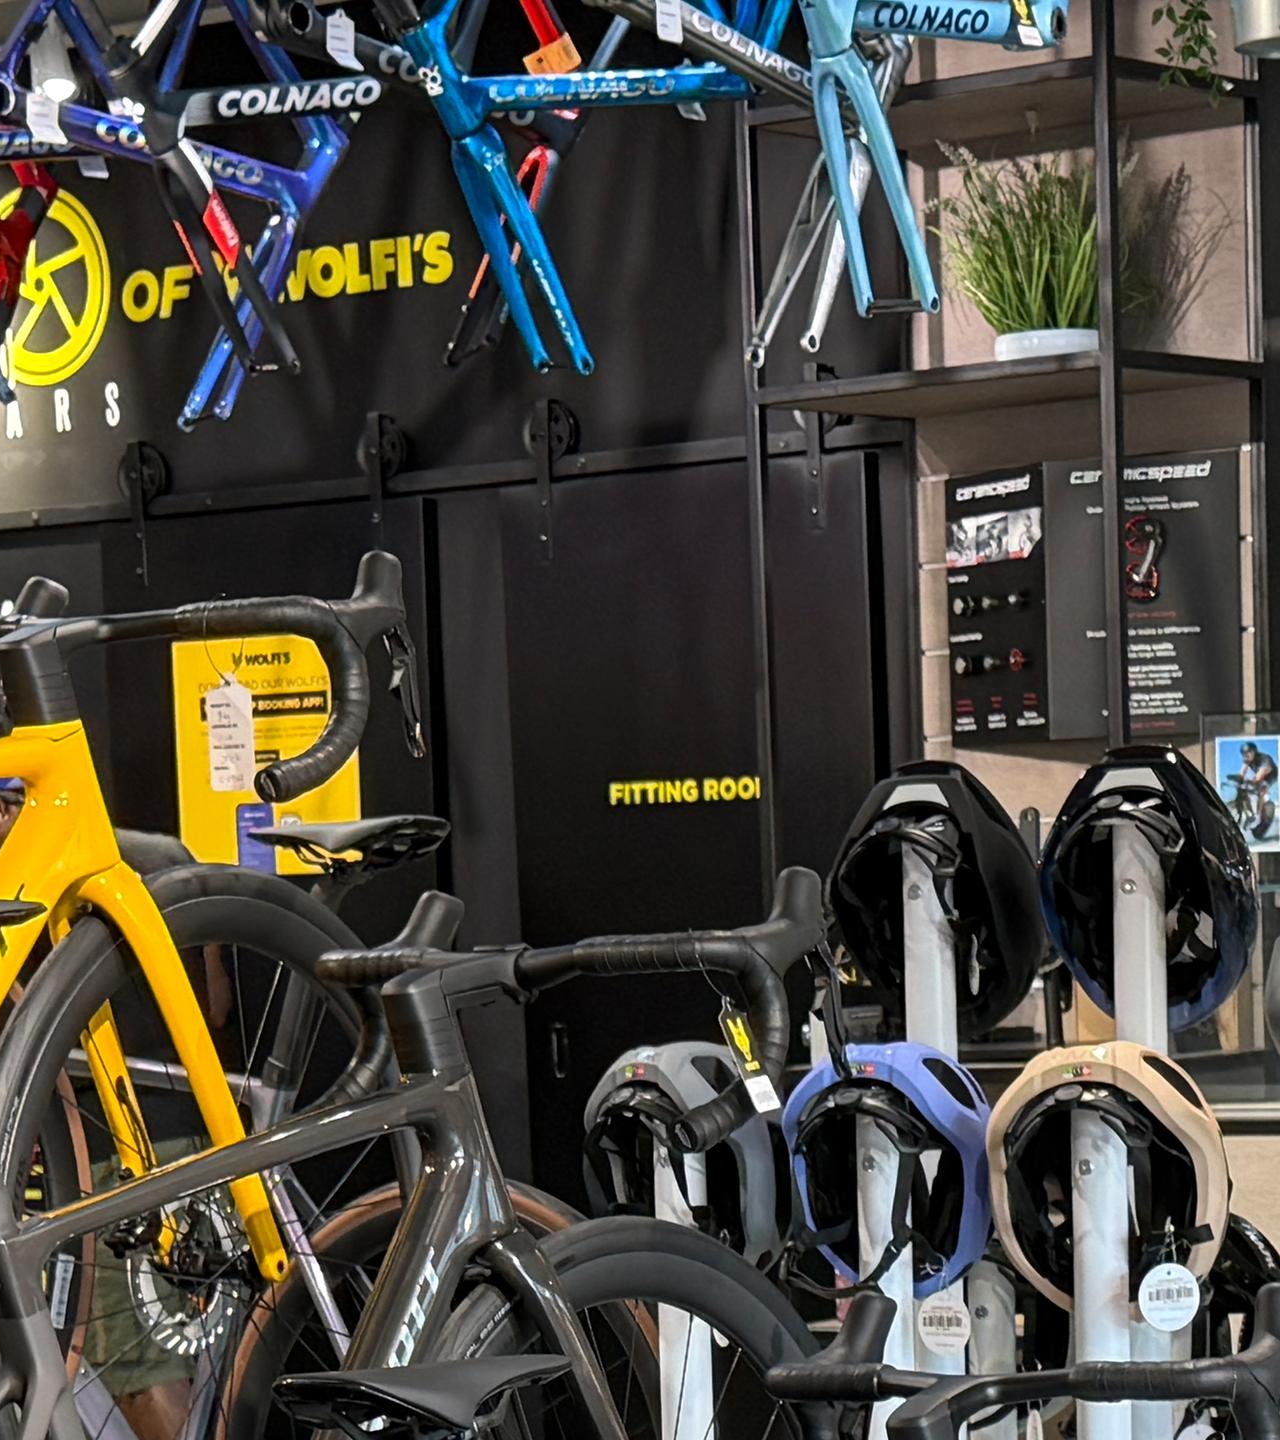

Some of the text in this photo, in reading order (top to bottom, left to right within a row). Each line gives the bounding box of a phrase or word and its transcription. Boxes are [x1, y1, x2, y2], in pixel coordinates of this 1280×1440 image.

[874, 5, 990, 34] COLNAGO
[218, 79, 382, 118] COLNAGO
[122, 265, 193, 322] OF
[610, 776, 760, 805] FITTING ROO
